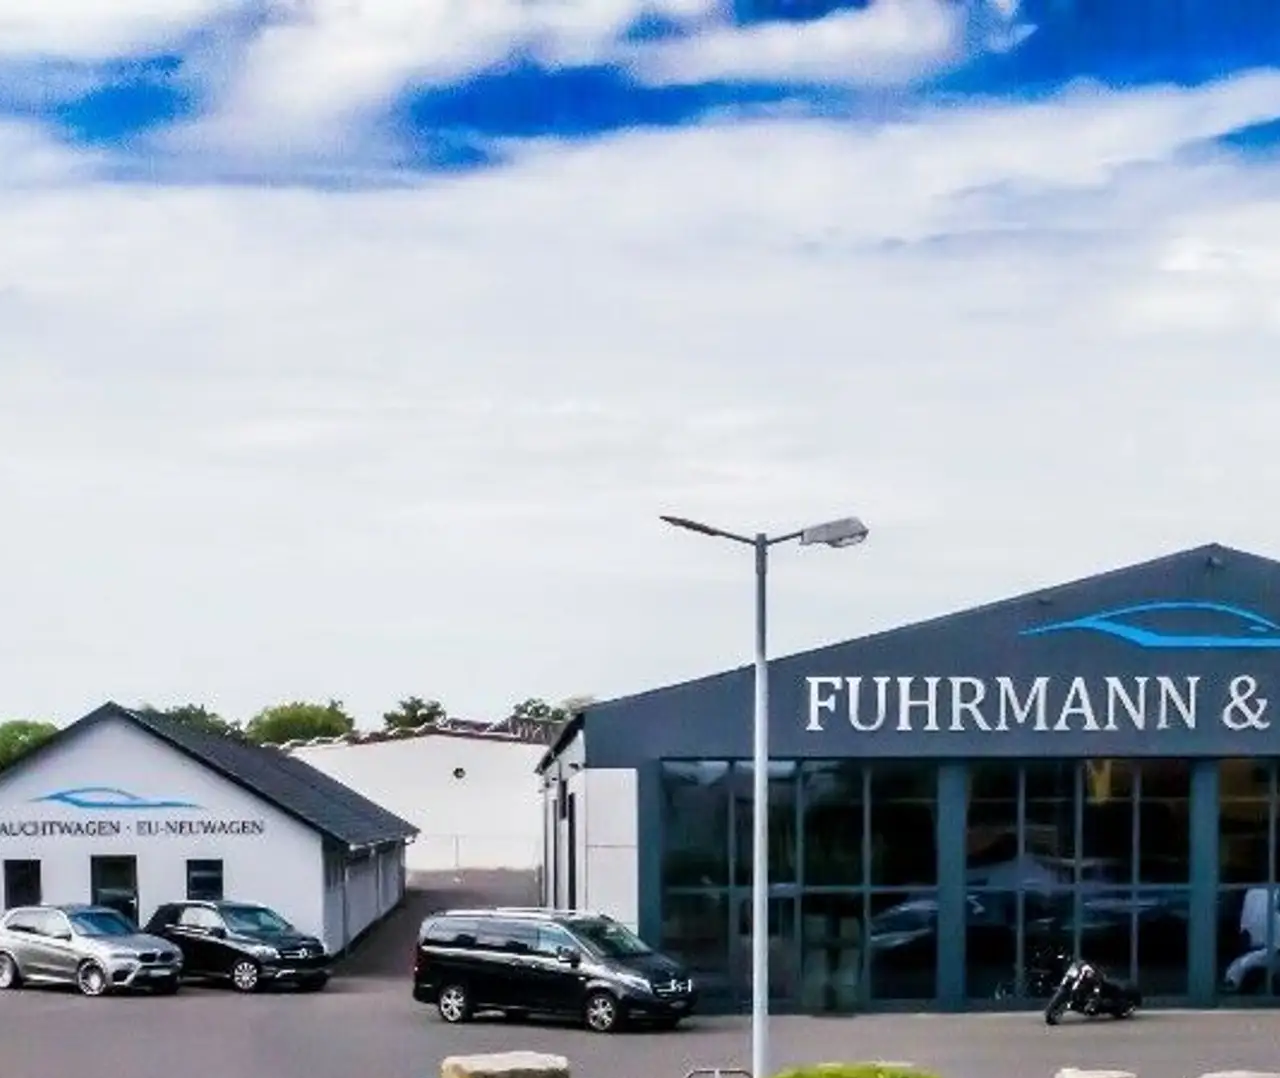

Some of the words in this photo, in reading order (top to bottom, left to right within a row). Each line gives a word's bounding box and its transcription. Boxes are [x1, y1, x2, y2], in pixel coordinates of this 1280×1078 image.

[804, 675, 1201, 732] FUHRMANN
[1221, 674, 1271, 731] &
[136, 819, 265, 836] EU-NEUWAGEN
